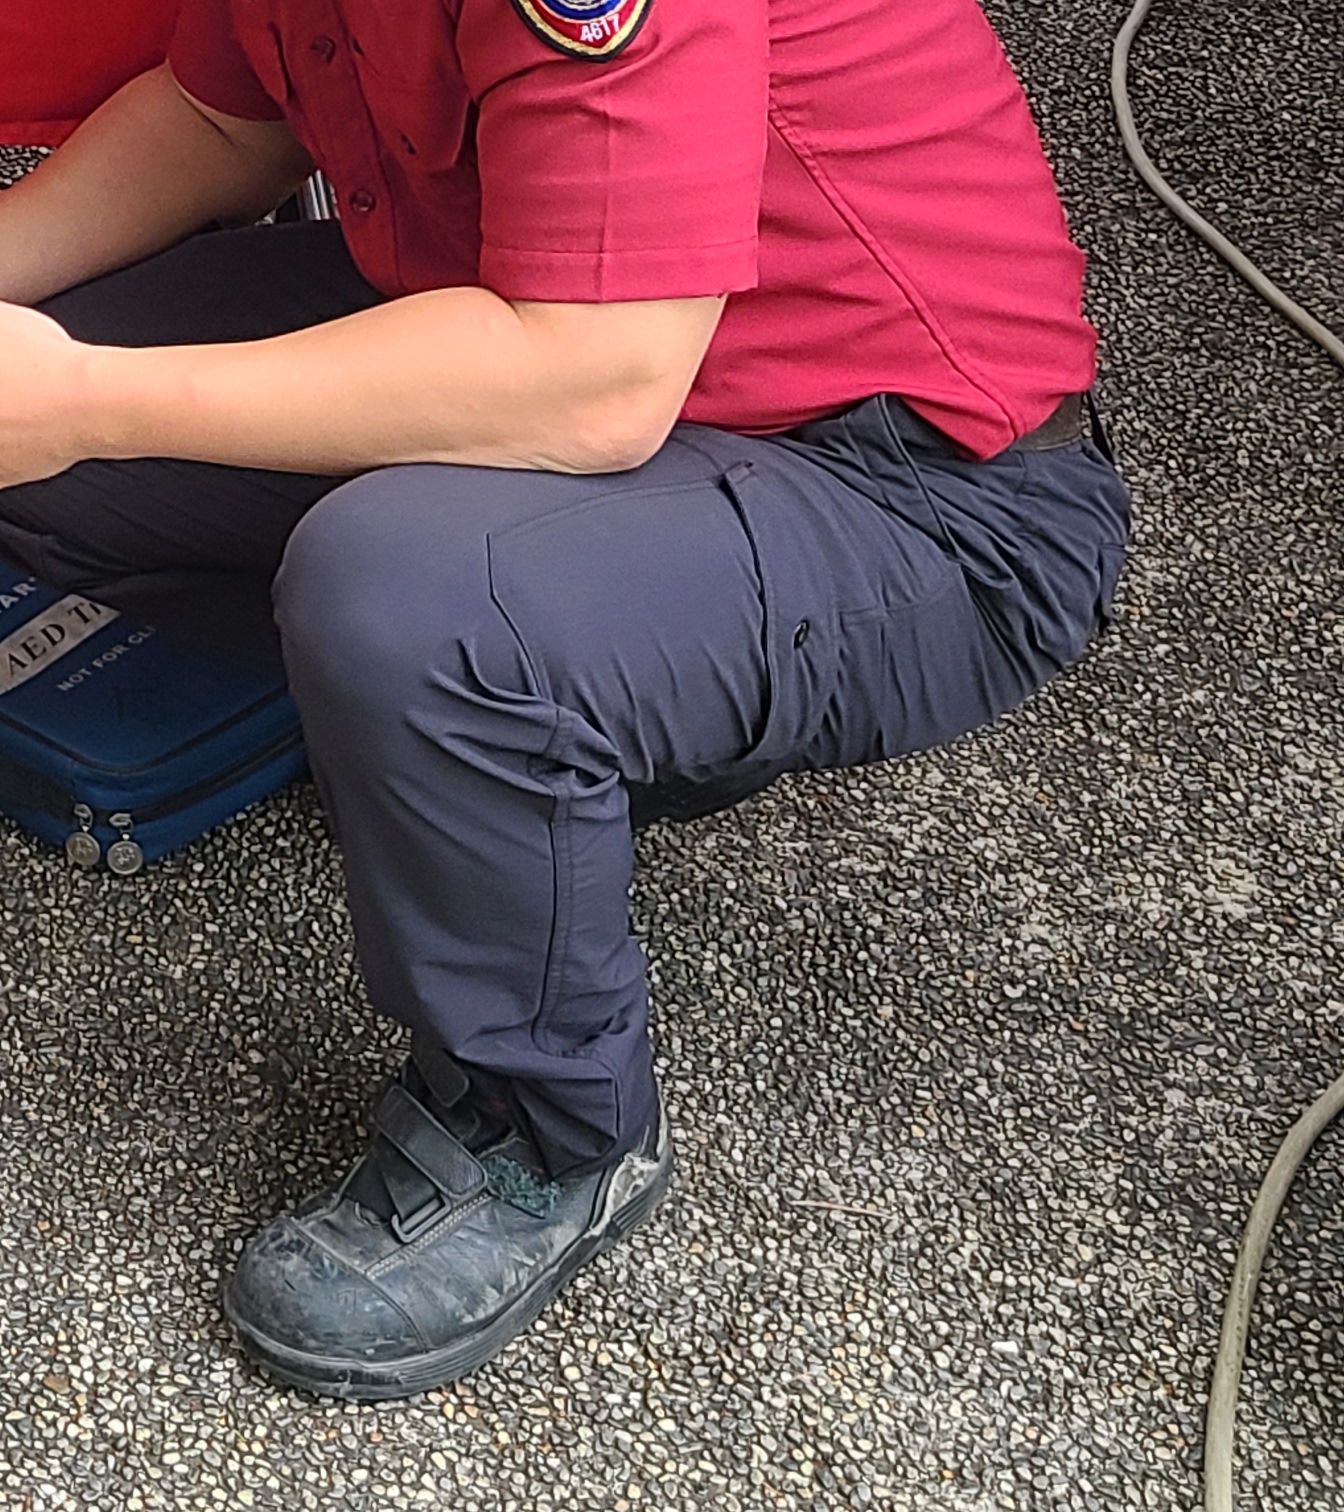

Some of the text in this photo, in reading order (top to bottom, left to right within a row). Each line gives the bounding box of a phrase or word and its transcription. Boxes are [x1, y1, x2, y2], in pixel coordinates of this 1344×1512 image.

[580, 13, 620, 43] 4617
[6, 623, 66, 676] AED
[56, 667, 93, 692] NOT
[92, 644, 129, 669] FOR
